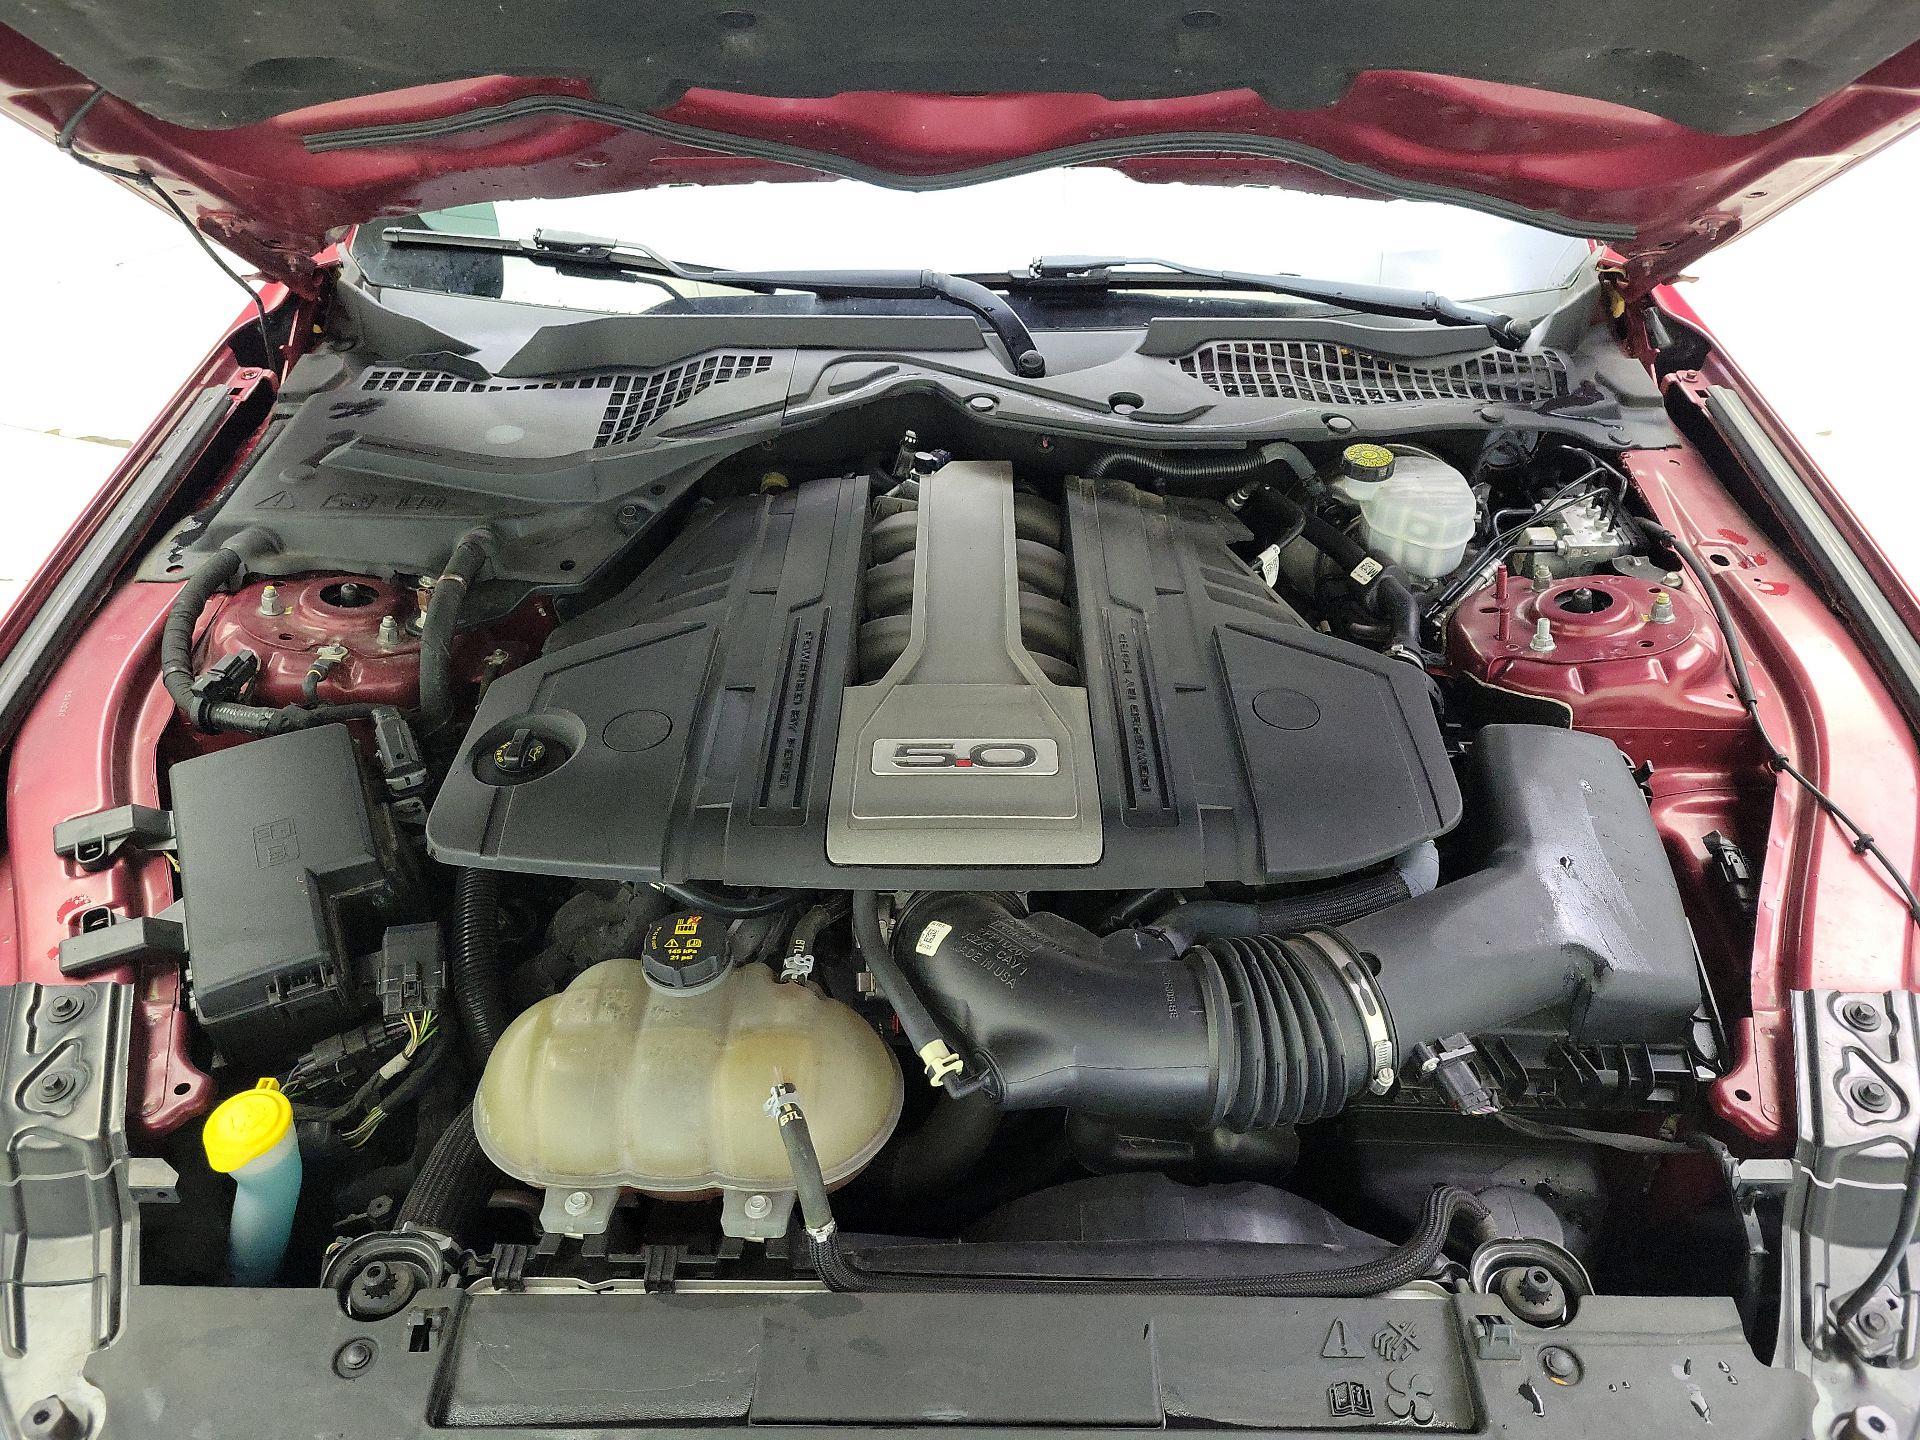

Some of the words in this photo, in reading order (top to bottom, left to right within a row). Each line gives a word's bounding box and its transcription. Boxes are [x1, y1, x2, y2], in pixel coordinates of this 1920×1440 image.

[892, 743, 1037, 768] 5.0
[793, 939, 806, 954] BTL
[994, 966, 1018, 990] USA
[779, 1111, 802, 1127] BTL
